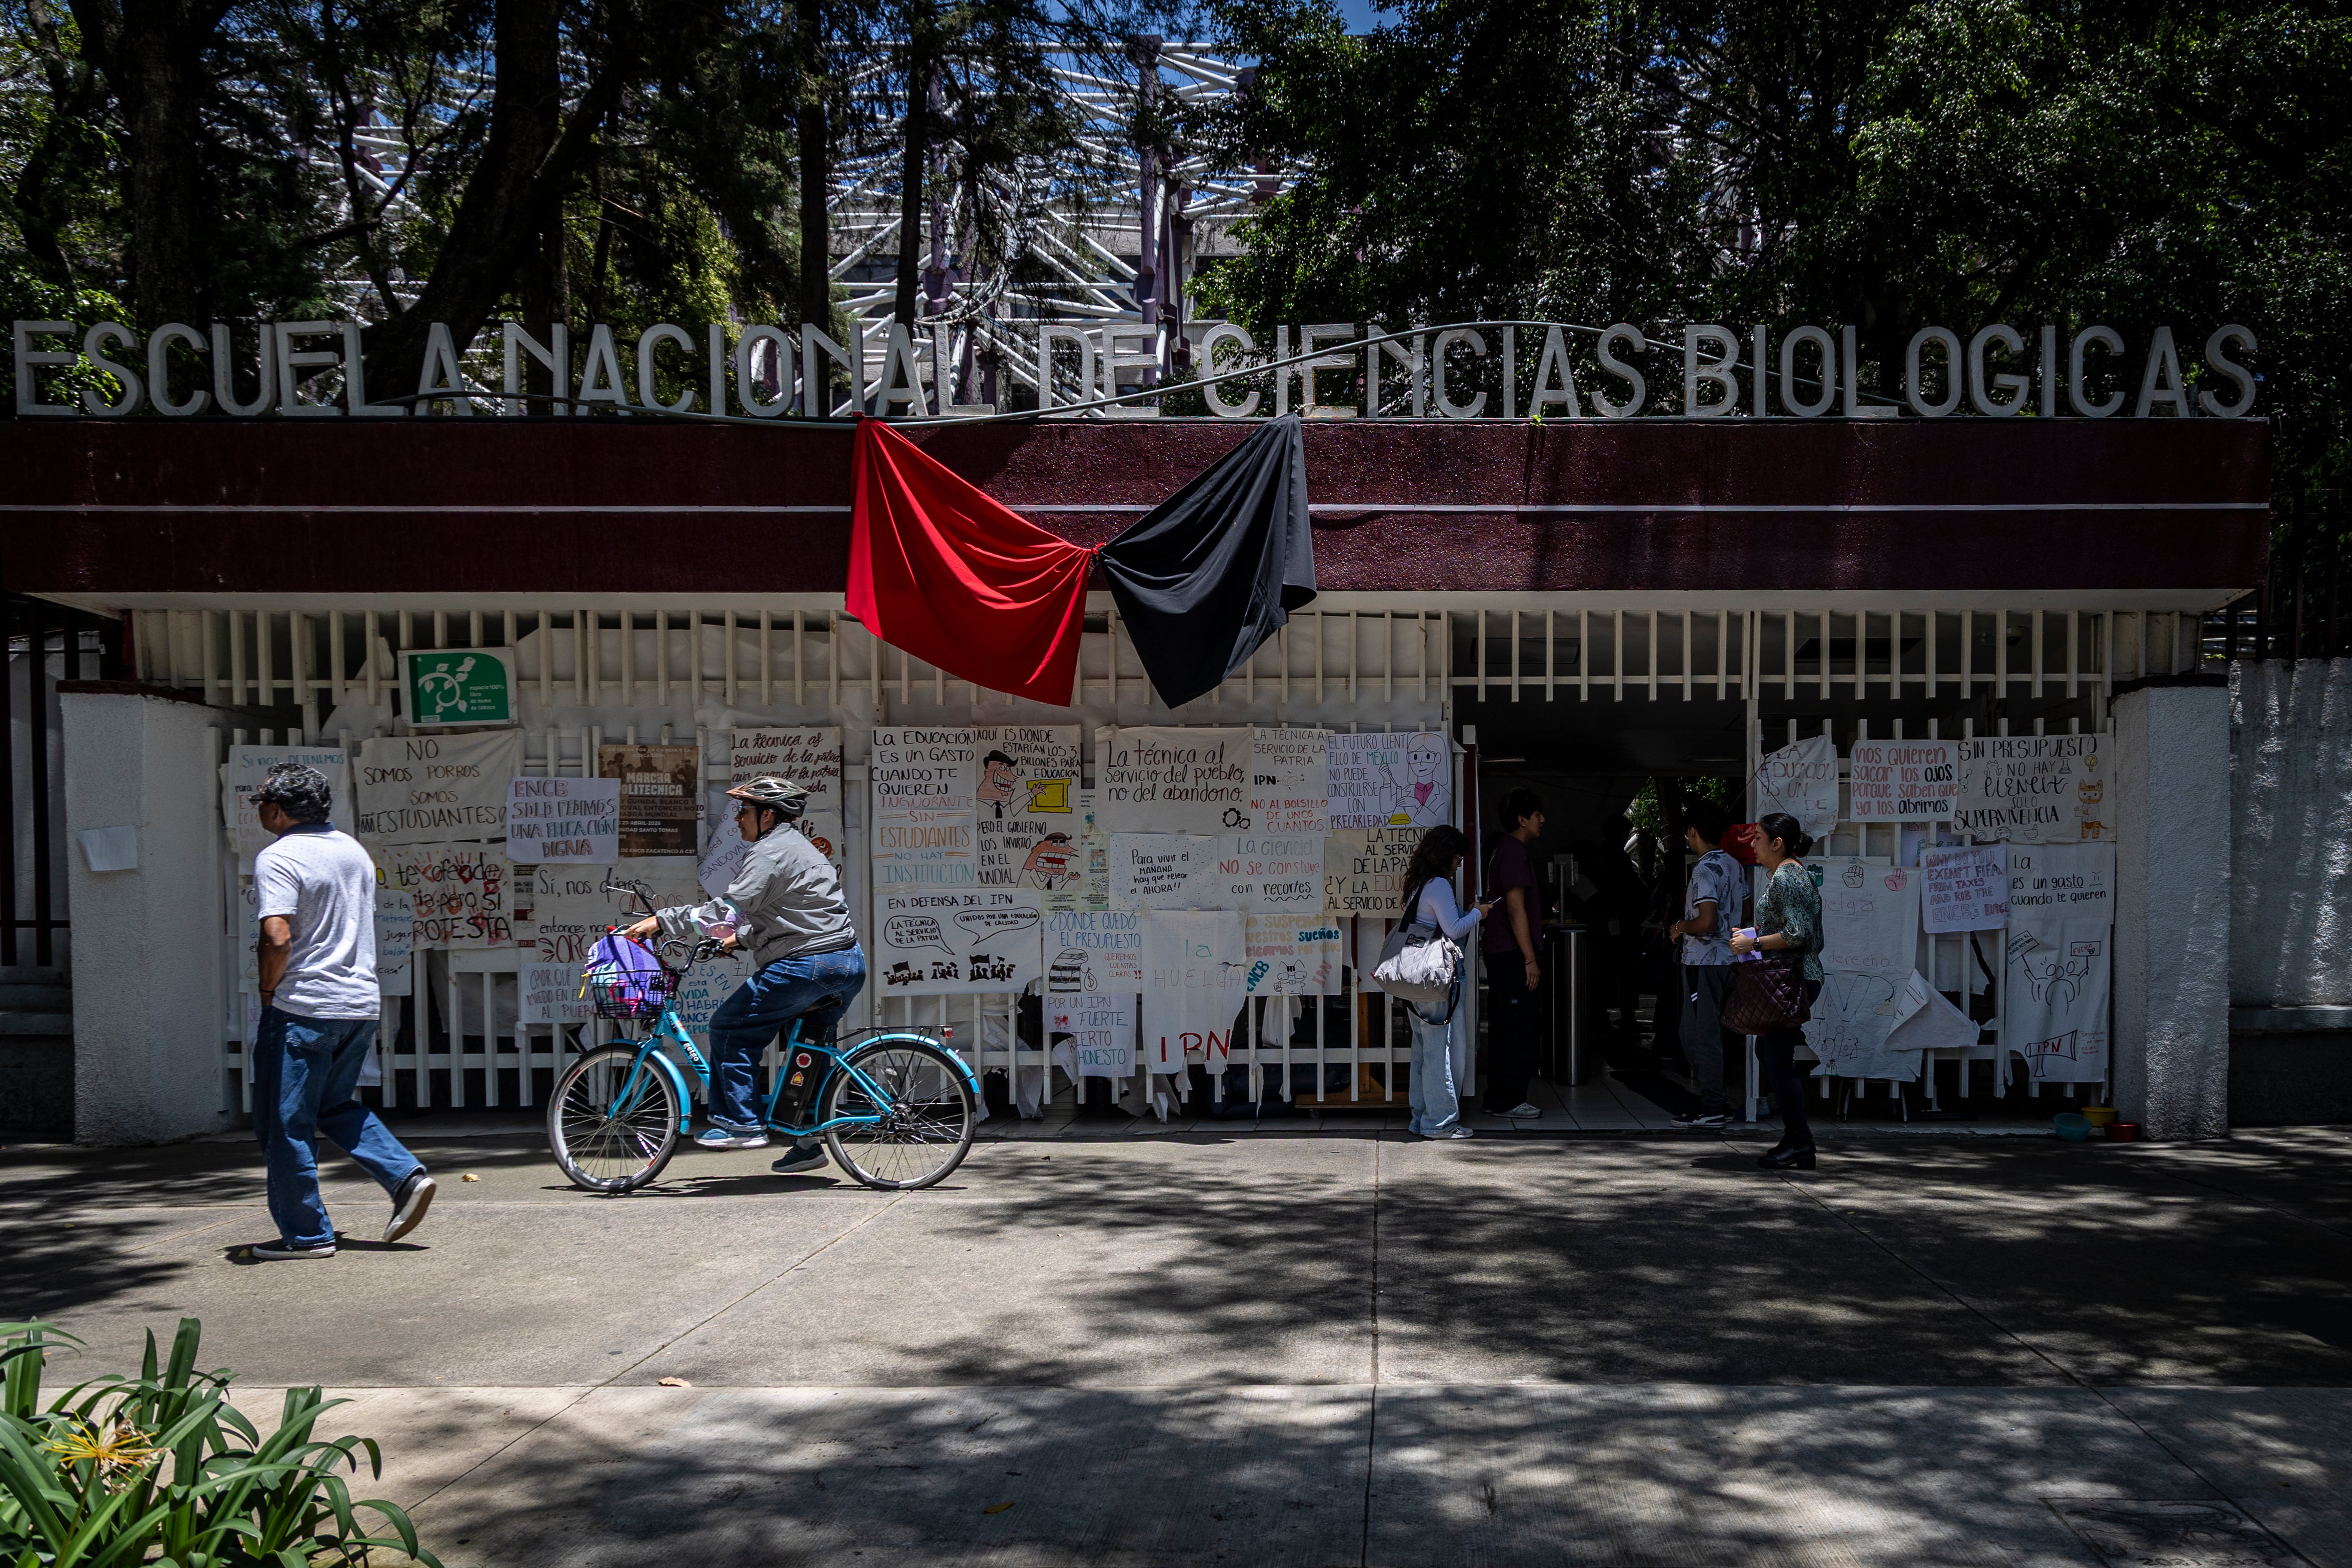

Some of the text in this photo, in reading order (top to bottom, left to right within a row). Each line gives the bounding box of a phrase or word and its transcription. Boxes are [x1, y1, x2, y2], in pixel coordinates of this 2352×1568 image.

[13, 320, 2258, 418] ESCUELA NACIONAL DE CIENCIAS BIOLOGICAS
[731, 733, 749, 750] La
[753, 732, 803, 749] técnica
[873, 729, 976, 746] La EDUCACIÓN
[977, 727, 1055, 743] AQUÍ ES DONDE
[406, 739, 439, 761] NO
[1003, 741, 1078, 759] ESTARÍAN LOS 3
[1108, 739, 1225, 767] La técnica al
[1254, 743, 1327, 755] SERVICIO DE LA
[1958, 736, 2098, 761] SIN PRESUPUESTO
[1021, 756, 1081, 768] BILLONES PARA
[1273, 755, 1315, 766] PATRIA
[1329, 748, 1399, 766] FICO DE MÉXICO
[364, 765, 480, 786] SOMOS PORROS
[872, 766, 958, 782] CUANDO TE
[1329, 768, 1369, 781] NO PUEDE
[1852, 764, 1953, 783] sacar los ojos
[2007, 760, 2056, 776] NO HAY
[626, 772, 671, 783] MARCHA
[515, 780, 569, 797] ENCB
[621, 784, 683, 796] OLITECNICA
[878, 782, 949, 796] QUIEREN
[1327, 781, 1379, 798] CONSTRUIRSE
[411, 790, 459, 805] SOMOS
[1251, 799, 1328, 810] NO AL BOLSILLO
[1348, 798, 1366, 813] CON
[1804, 799, 1827, 811] DE
[1266, 810, 1314, 820] DE UNOS
[1855, 798, 1948, 816] ya los abrimos
[909, 810, 935, 822] SIN
[1330, 814, 1391, 829] PRECARIEDAD
[1954, 805, 2060, 831] SUPERVIVENCIA
[1267, 819, 1325, 834] CUANTOS
[880, 825, 970, 849] ESTUDIANTES
[980, 835, 1033, 852] LOS INVIRTIÓ
[1367, 828, 1384, 843] LA
[542, 839, 593, 858] DIGNA
[1237, 836, 1313, 856] La ciencia
[1365, 844, 1379, 856] AL
[700, 841, 749, 881] SANDOVAL
[895, 851, 945, 860] NO HAY
[981, 853, 1011, 867] EN EL
[2014, 854, 2031, 869] La
[882, 860, 976, 883] INSTITUCIÓN
[1139, 864, 1173, 875] MAÑANA
[1354, 858, 1389, 874] DE LA
[1927, 863, 2003, 881] EXEMPT FIFA
[395, 863, 420, 886] te
[2012, 873, 2084, 890] es un gasto
[539, 869, 562, 898] Sí,
[566, 880, 592, 895] nos
[1231, 880, 1312, 896] con recortes
[1928, 877, 1985, 893] FROM TAXES
[888, 894, 1014, 909] EN DEFENSA DEL IPN
[1328, 896, 1398, 910] AL SERVICIO DE
[2010, 890, 2107, 906] cuando te quieren
[891, 918, 936, 930] LA TÉCNICA
[1061, 931, 1141, 949] EL PRESUPUESTO
[1104, 952, 1137, 961] QUEREMOS
[2072, 943, 2093, 955] FUERA
[530, 967, 572, 990] ¿POR QUÉ
[1154, 968, 1241, 990] HUELGA
[526, 988, 568, 1006] MIEDO EN
[681, 988, 709, 1000] VIDA
[1048, 996, 1111, 1009] POR UN IPN
[541, 1004, 554, 1019] AL
[1077, 1011, 1129, 1027] FUERTE
[2037, 1038, 2062, 1053] IPN
[1077, 1048, 1126, 1066] HONESTO
